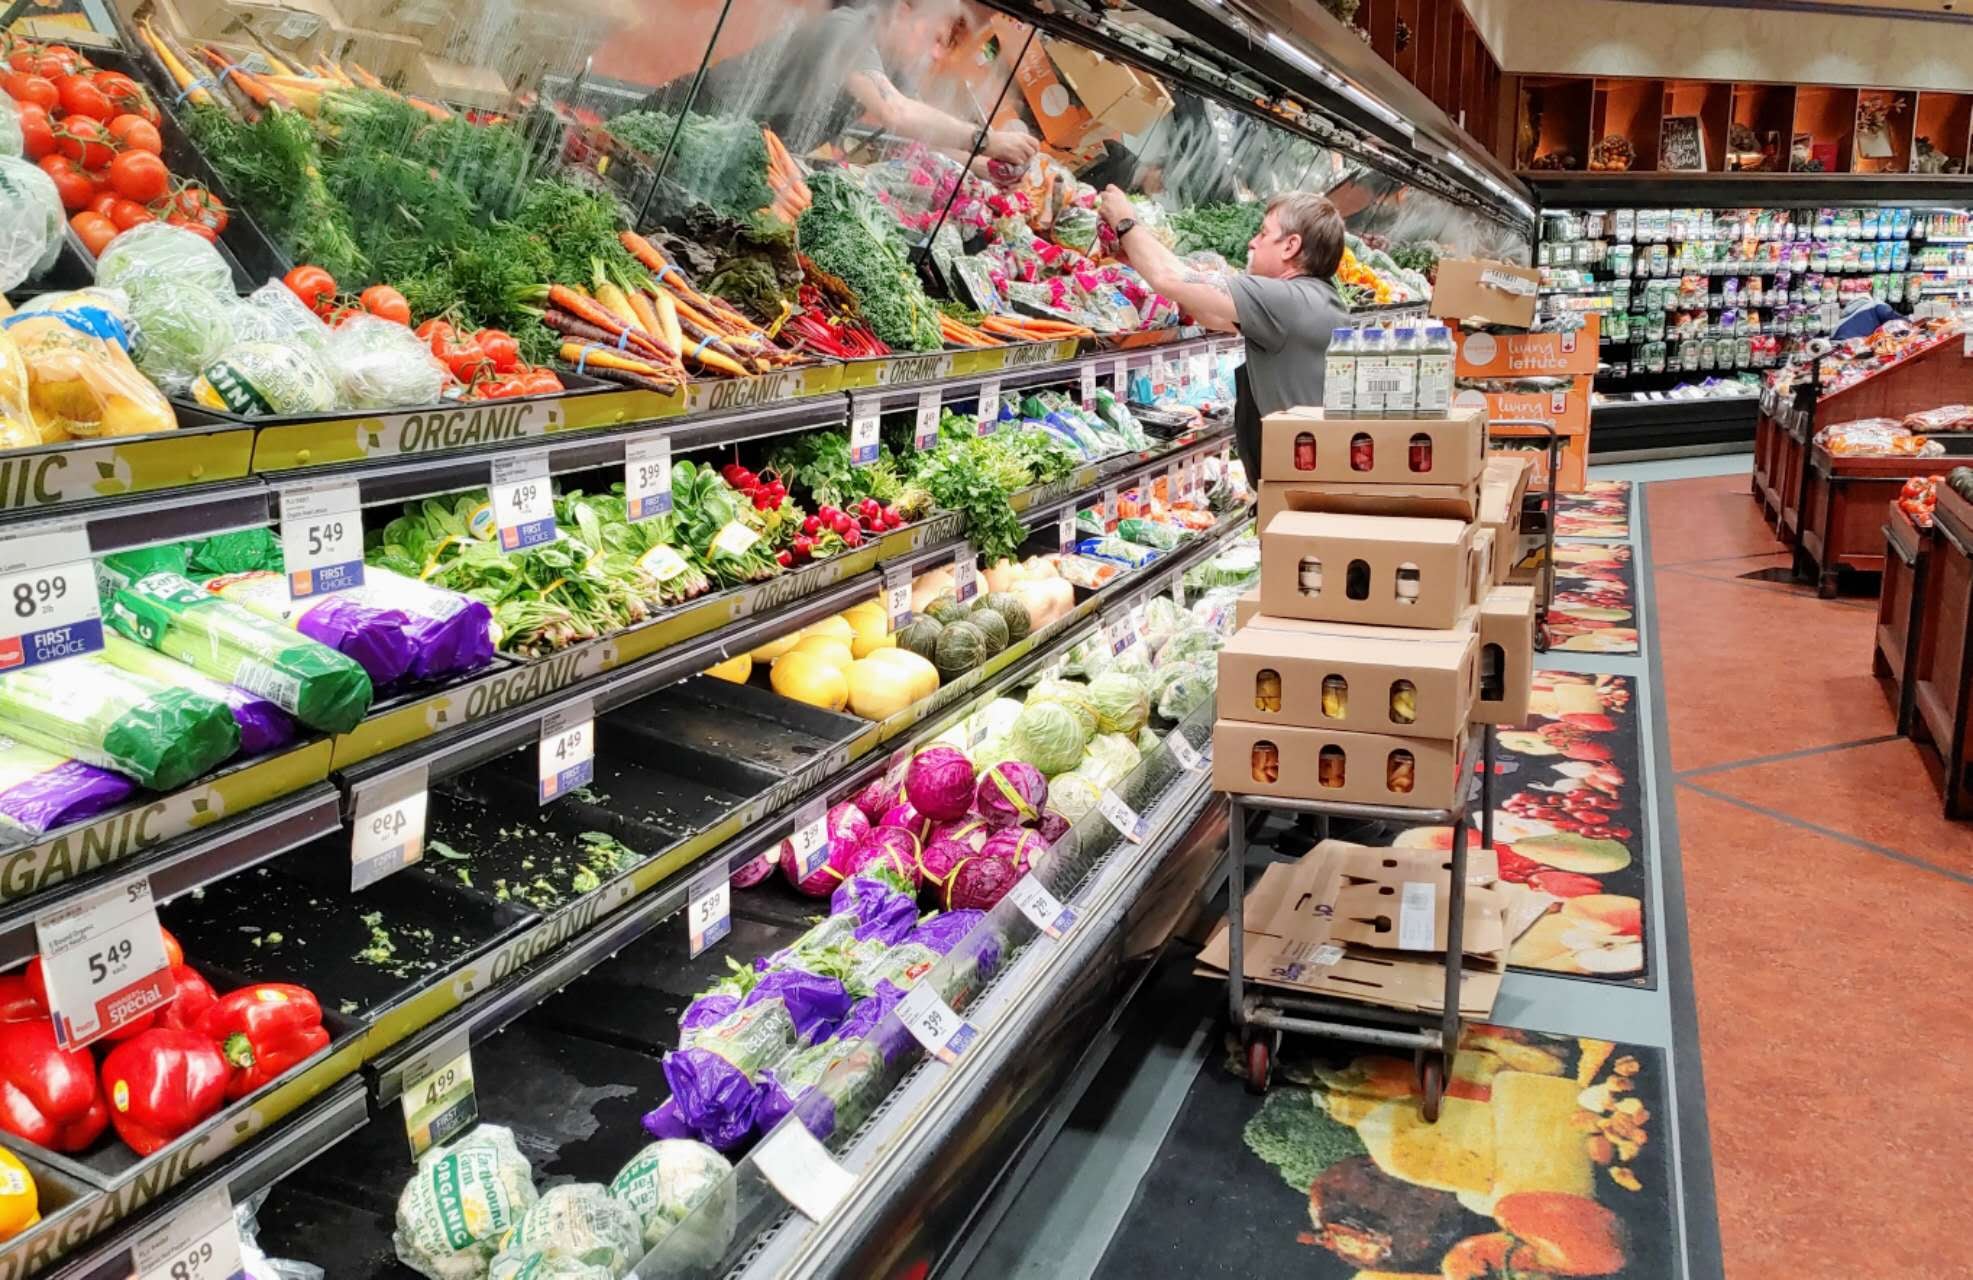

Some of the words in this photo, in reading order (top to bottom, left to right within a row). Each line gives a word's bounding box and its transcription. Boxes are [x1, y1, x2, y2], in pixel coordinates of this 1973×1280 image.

[1508, 336, 1554, 360] living
[1508, 354, 1568, 369] lettuce
[890, 356, 943, 384] ORGANIC
[709, 374, 788, 410] ORGANIC
[1497, 397, 1544, 420] living
[399, 403, 533, 452] ORGANIC
[639, 464, 660, 489] 399
[512, 484, 537, 511] 499
[309, 522, 343, 555] 549
[522, 523, 541, 535] FIRST
[925, 511, 968, 545] ORGAN
[320, 566, 345, 580] FIRST
[320, 576, 353, 591] CHOICE
[13, 575, 67, 617] 899
[753, 566, 826, 614] ORGANIC
[34, 628, 72, 648] FIRST
[36, 639, 85, 660] CHOICE
[464, 649, 588, 721] ORGANIC
[556, 731, 581, 760] 449
[0, 802, 166, 899] GANIC
[126, 879, 147, 903] 599
[702, 893, 720, 922] 599
[490, 893, 607, 984] ORGANIC
[88, 939, 132, 985] 549
[744, 1012, 784, 1054] CELERY
[923, 1010, 942, 1037] 399
[426, 1069, 454, 1104] 499
[436, 1107, 457, 1129] FIRST
[460, 1152, 475, 1185] Farm
[437, 1161, 467, 1244] ORGANIC
[477, 1152, 507, 1229] Earthbound
[170, 1242, 212, 1280] 899
